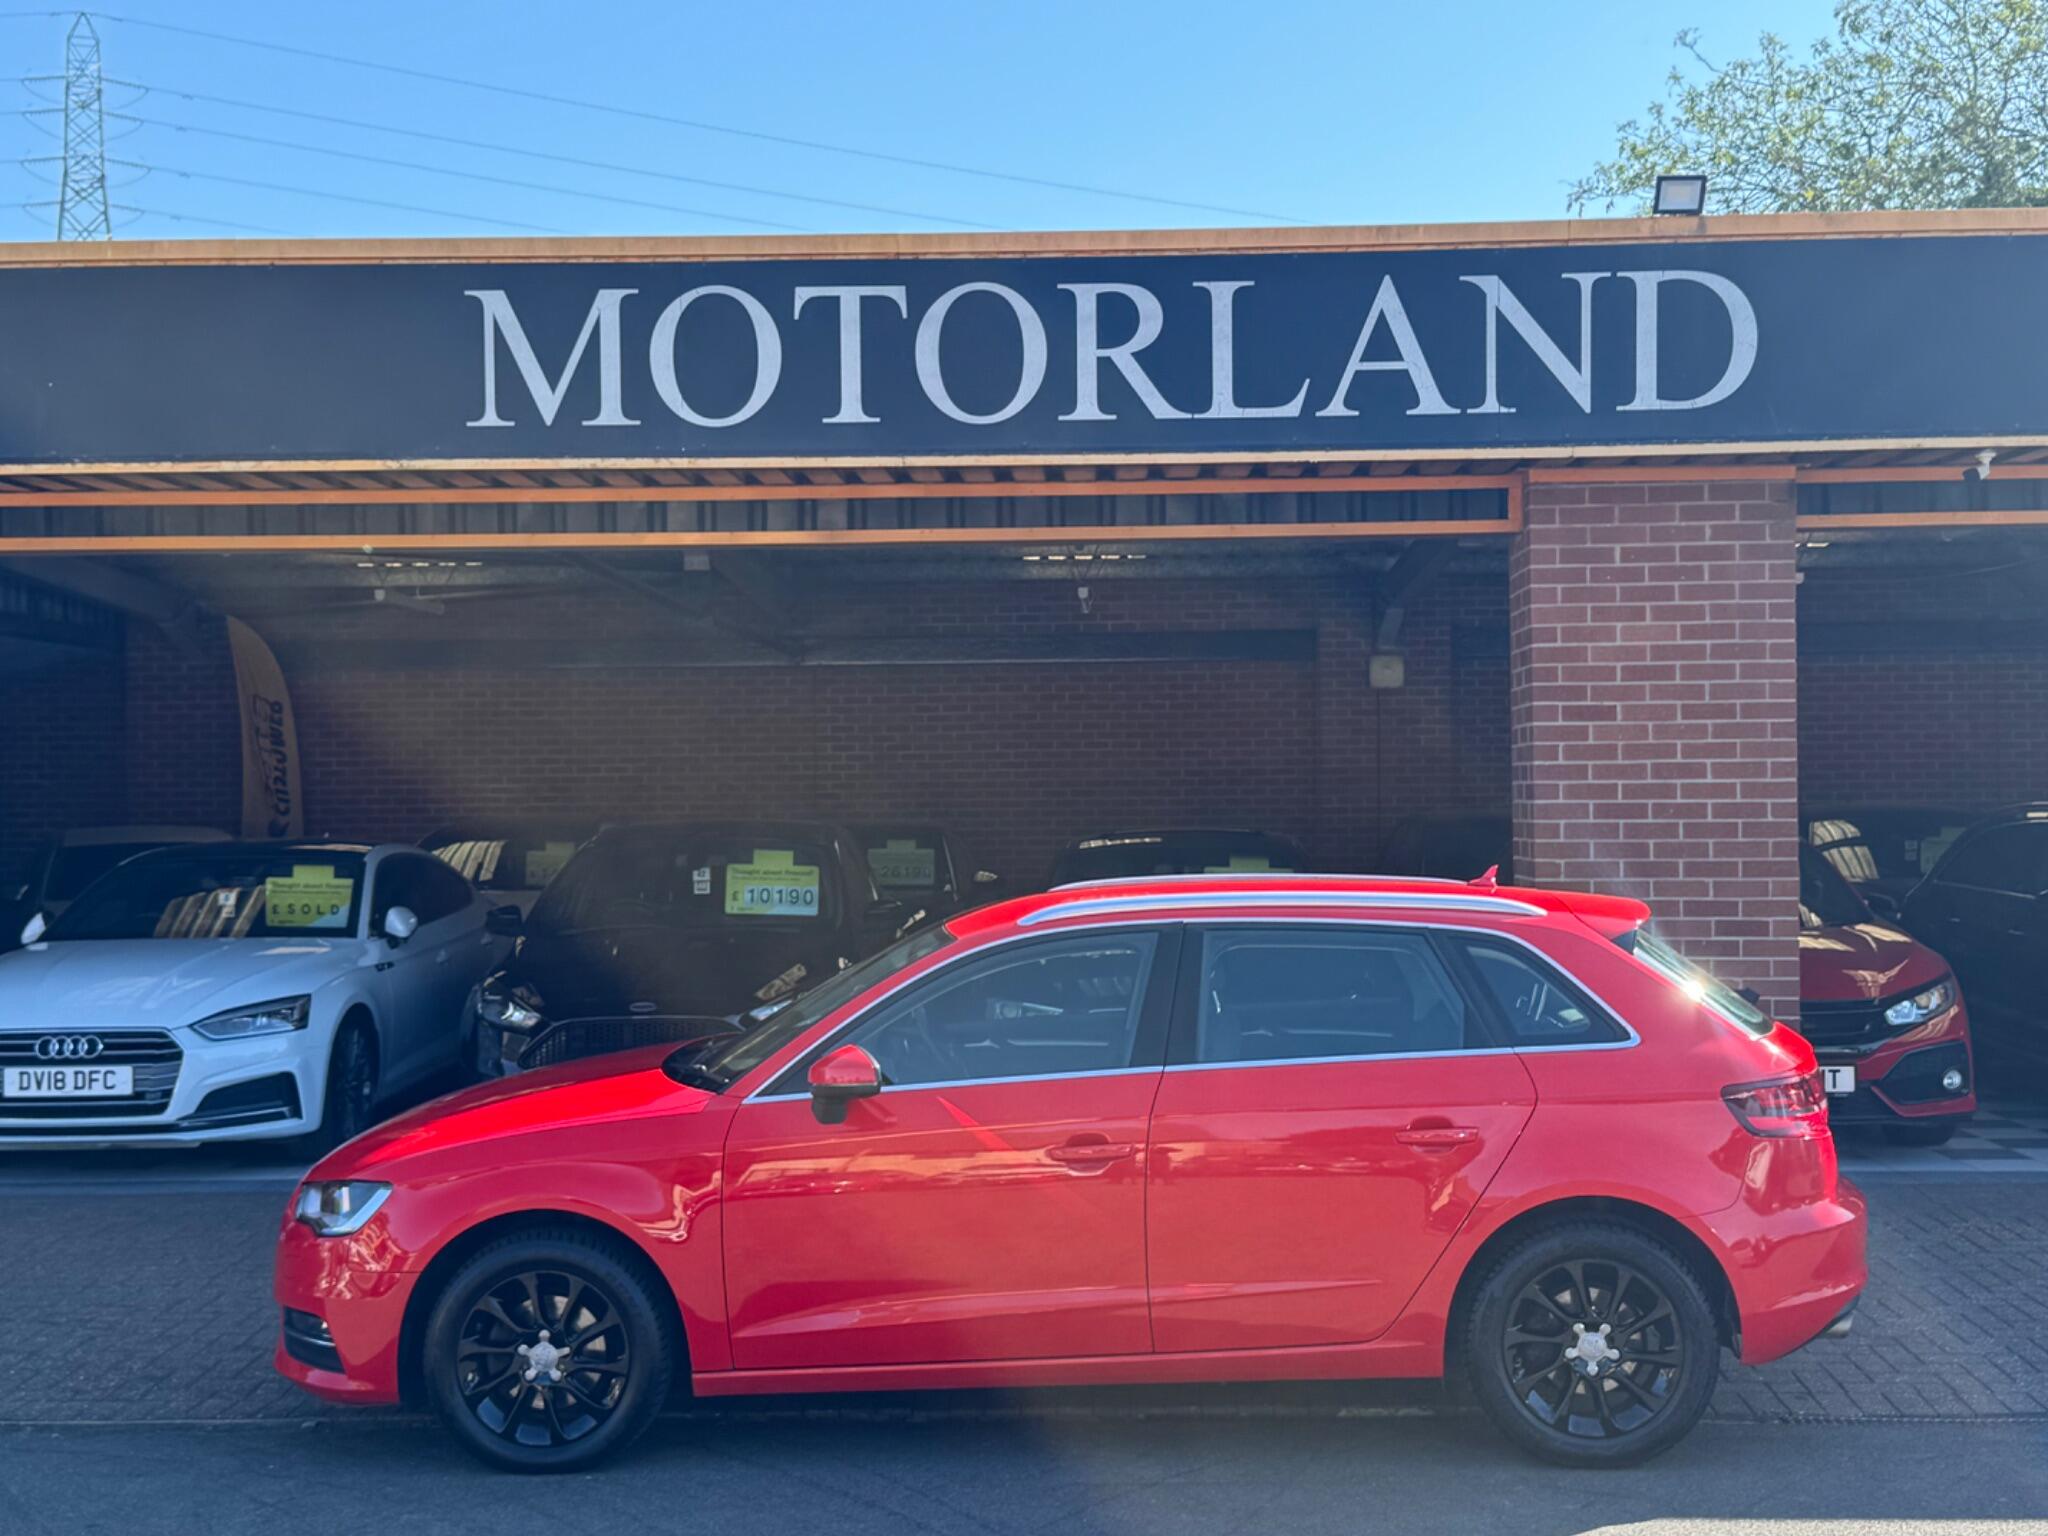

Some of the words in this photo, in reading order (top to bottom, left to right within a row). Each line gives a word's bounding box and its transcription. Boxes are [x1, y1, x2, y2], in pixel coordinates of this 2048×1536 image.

[464, 270, 1758, 427] MOTORLAND
[747, 888, 814, 905] 10190
[288, 903, 340, 915] SOLD
[18, 1070, 67, 1091] DV18
[73, 1069, 117, 1090] DFC
